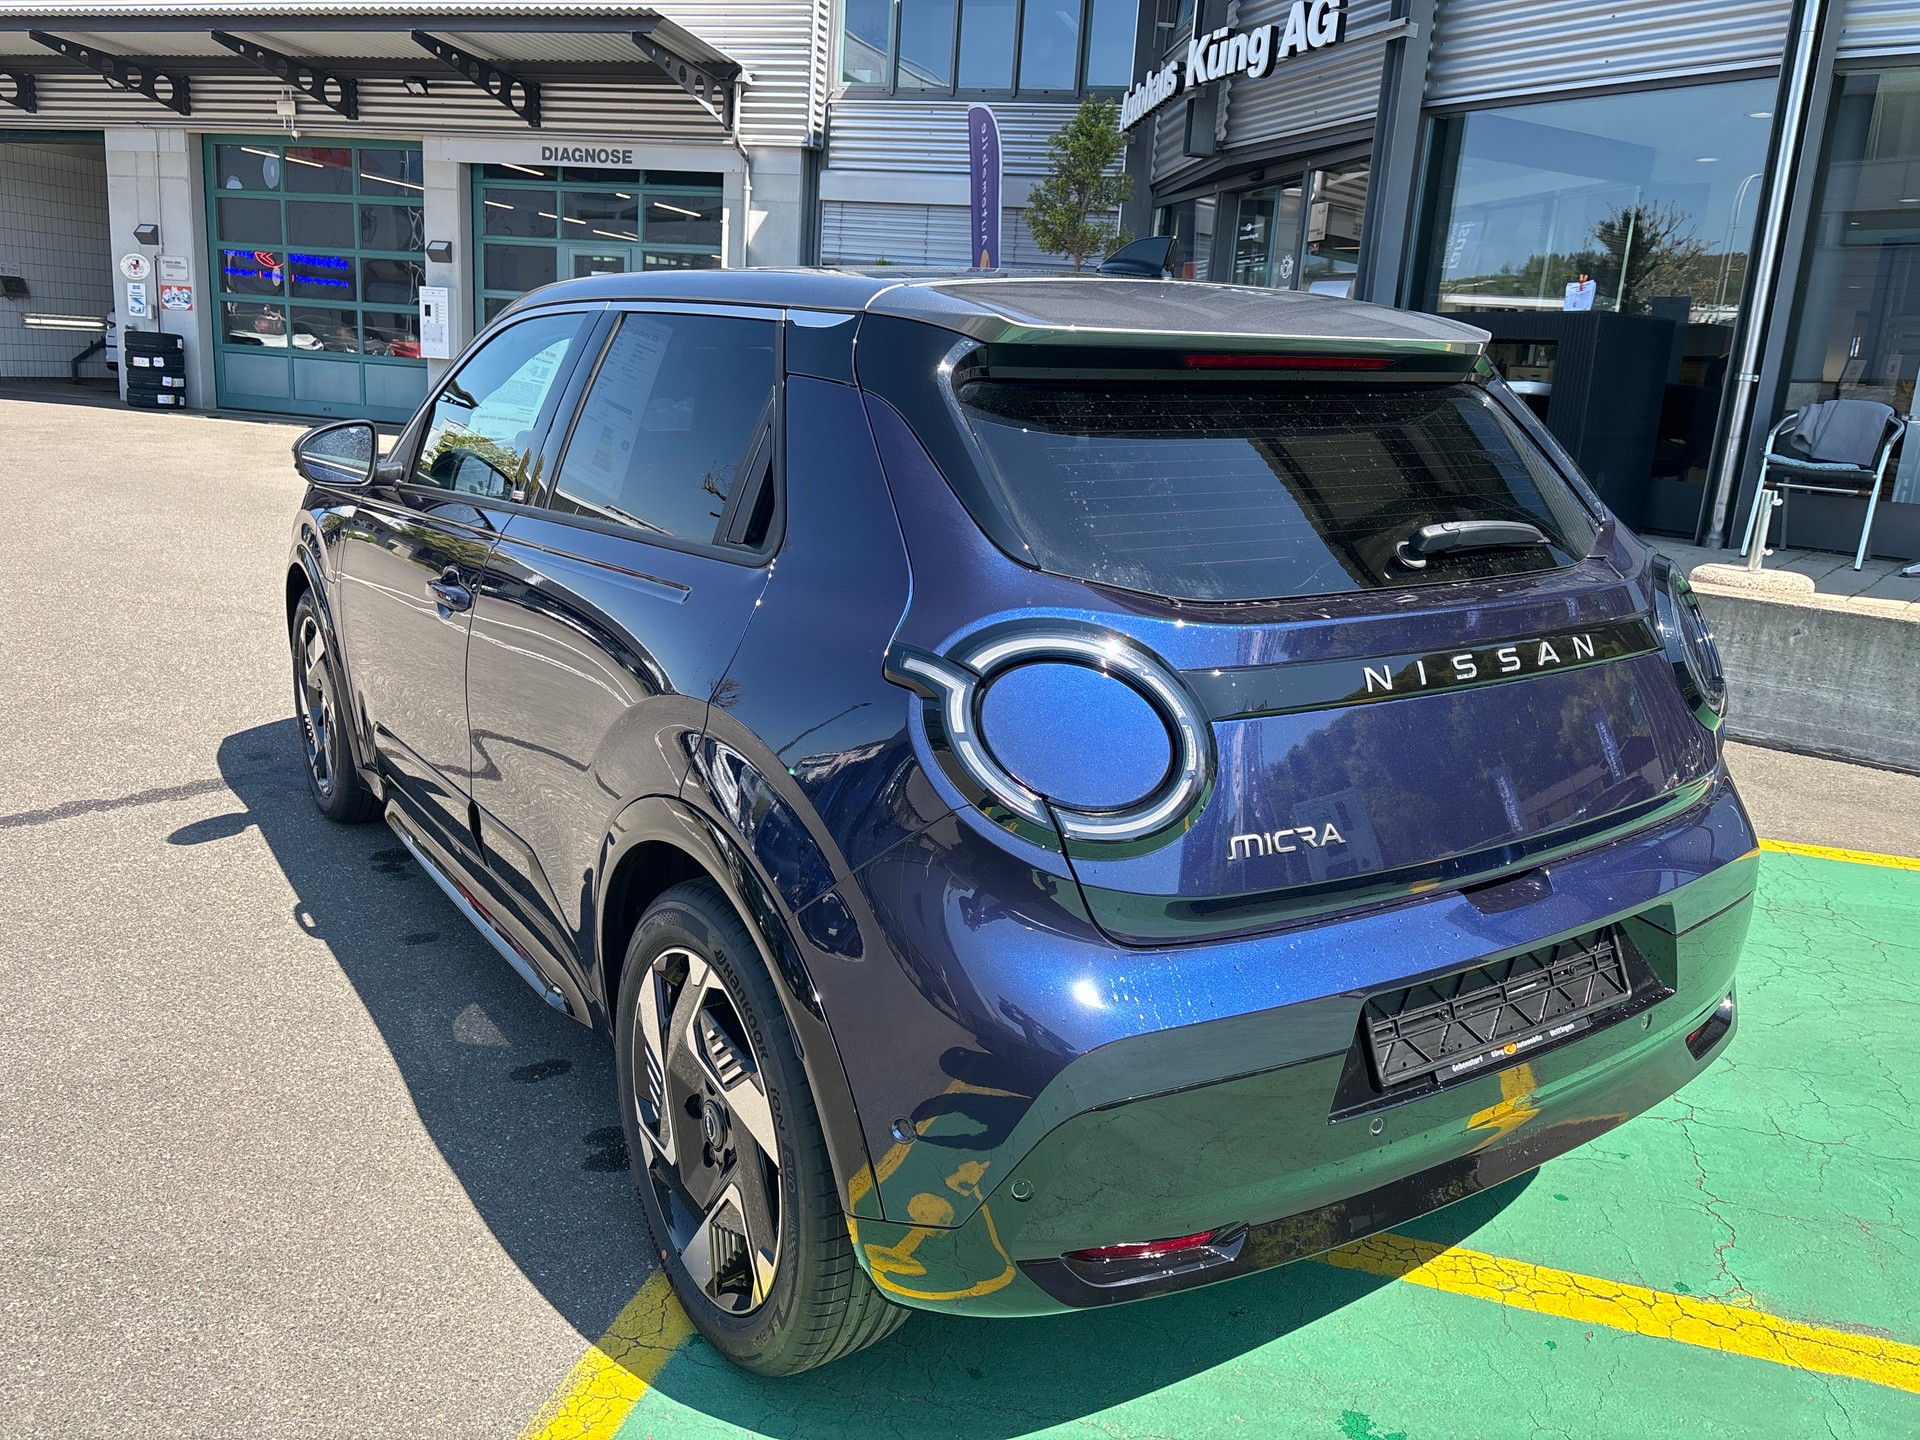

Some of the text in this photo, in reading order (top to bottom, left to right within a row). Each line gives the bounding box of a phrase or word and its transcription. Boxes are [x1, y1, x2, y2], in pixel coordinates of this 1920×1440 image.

[1120, 0, 1343, 132] Autohaus Küng AG
[541, 146, 633, 165] DIAGNOSE
[1363, 634, 1595, 693] NISSAN
[1226, 822, 1346, 861] MICRA
